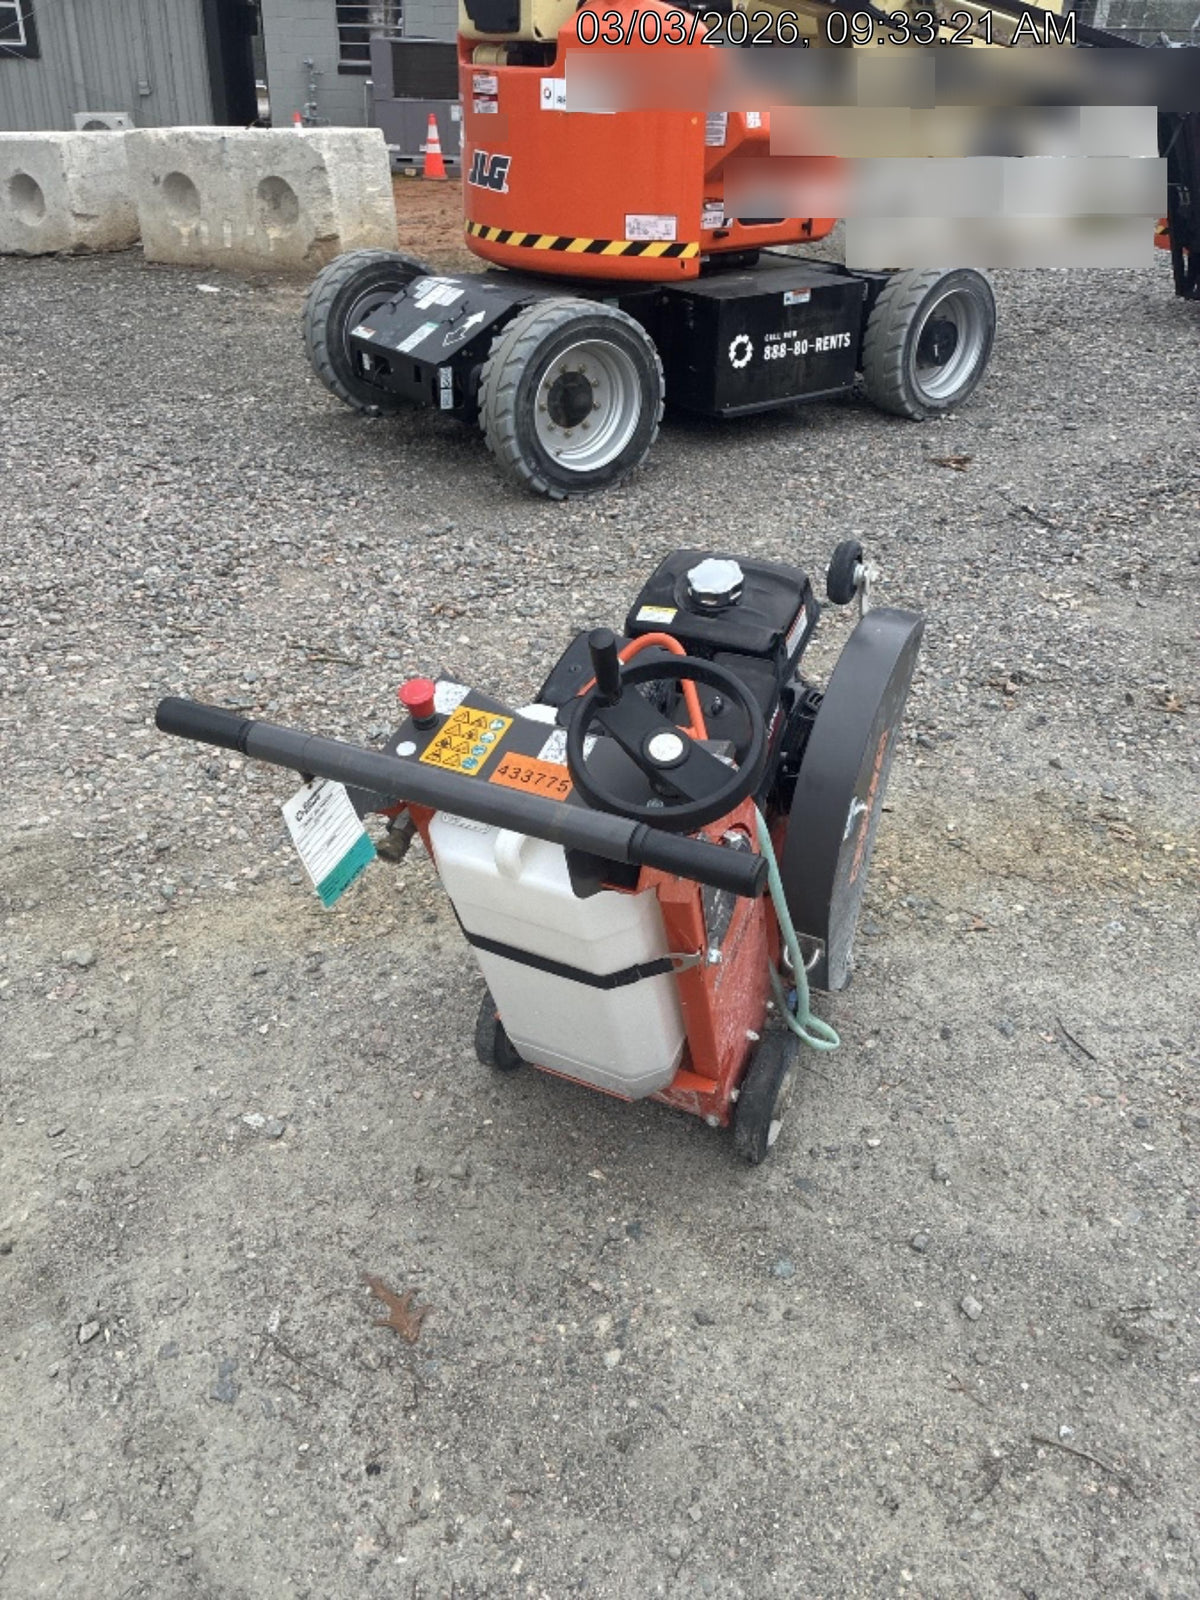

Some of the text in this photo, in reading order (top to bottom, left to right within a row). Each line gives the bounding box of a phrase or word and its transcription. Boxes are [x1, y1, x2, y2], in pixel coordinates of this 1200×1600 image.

[468, 149, 512, 194] JLG
[763, 332, 851, 360] 888-80-RENTS
[497, 764, 571, 793] 433775
